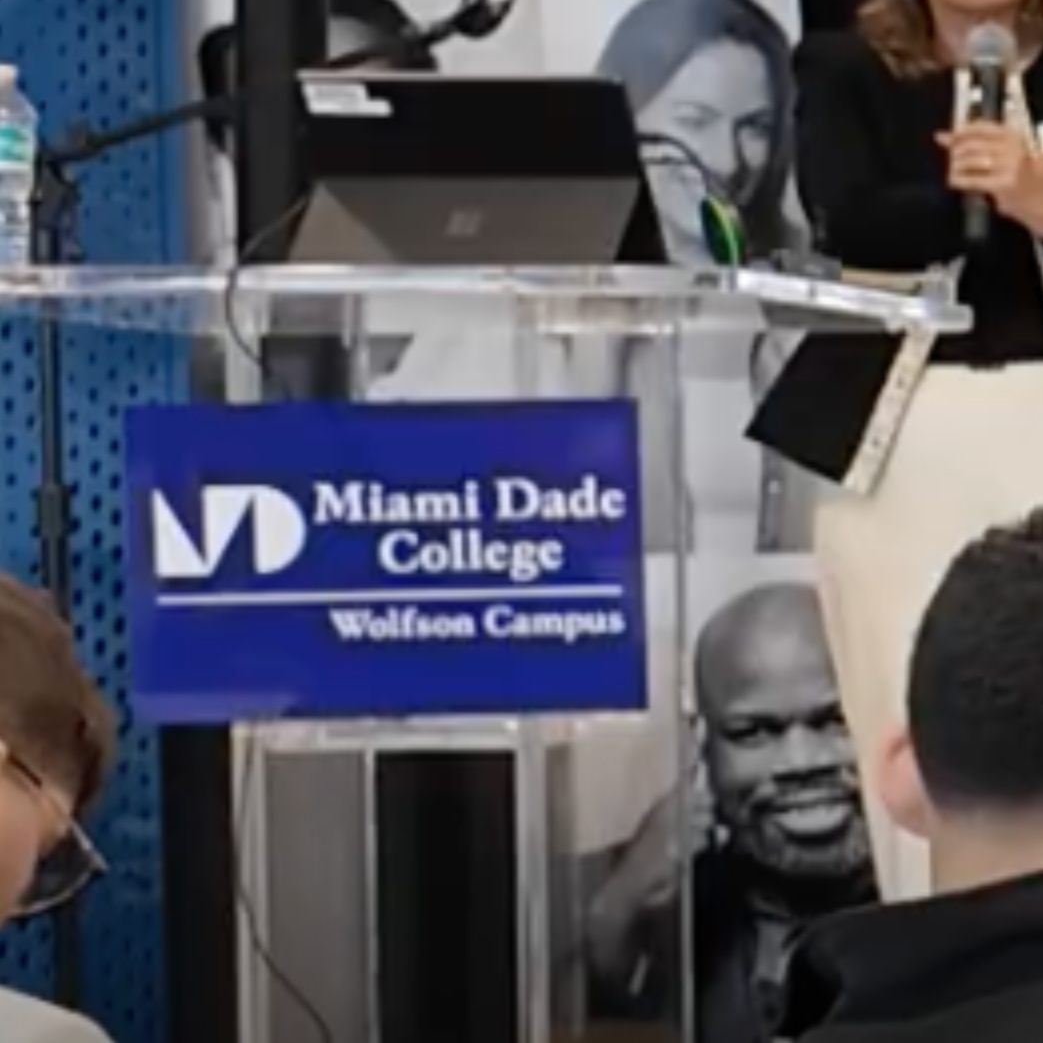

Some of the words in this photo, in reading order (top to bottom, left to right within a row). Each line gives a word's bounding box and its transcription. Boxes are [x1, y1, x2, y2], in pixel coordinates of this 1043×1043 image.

[313, 480, 480, 523] Miami
[494, 475, 626, 519] Dade
[378, 531, 564, 581] College
[329, 609, 475, 641] Wolfson
[483, 604, 625, 643] Campus
